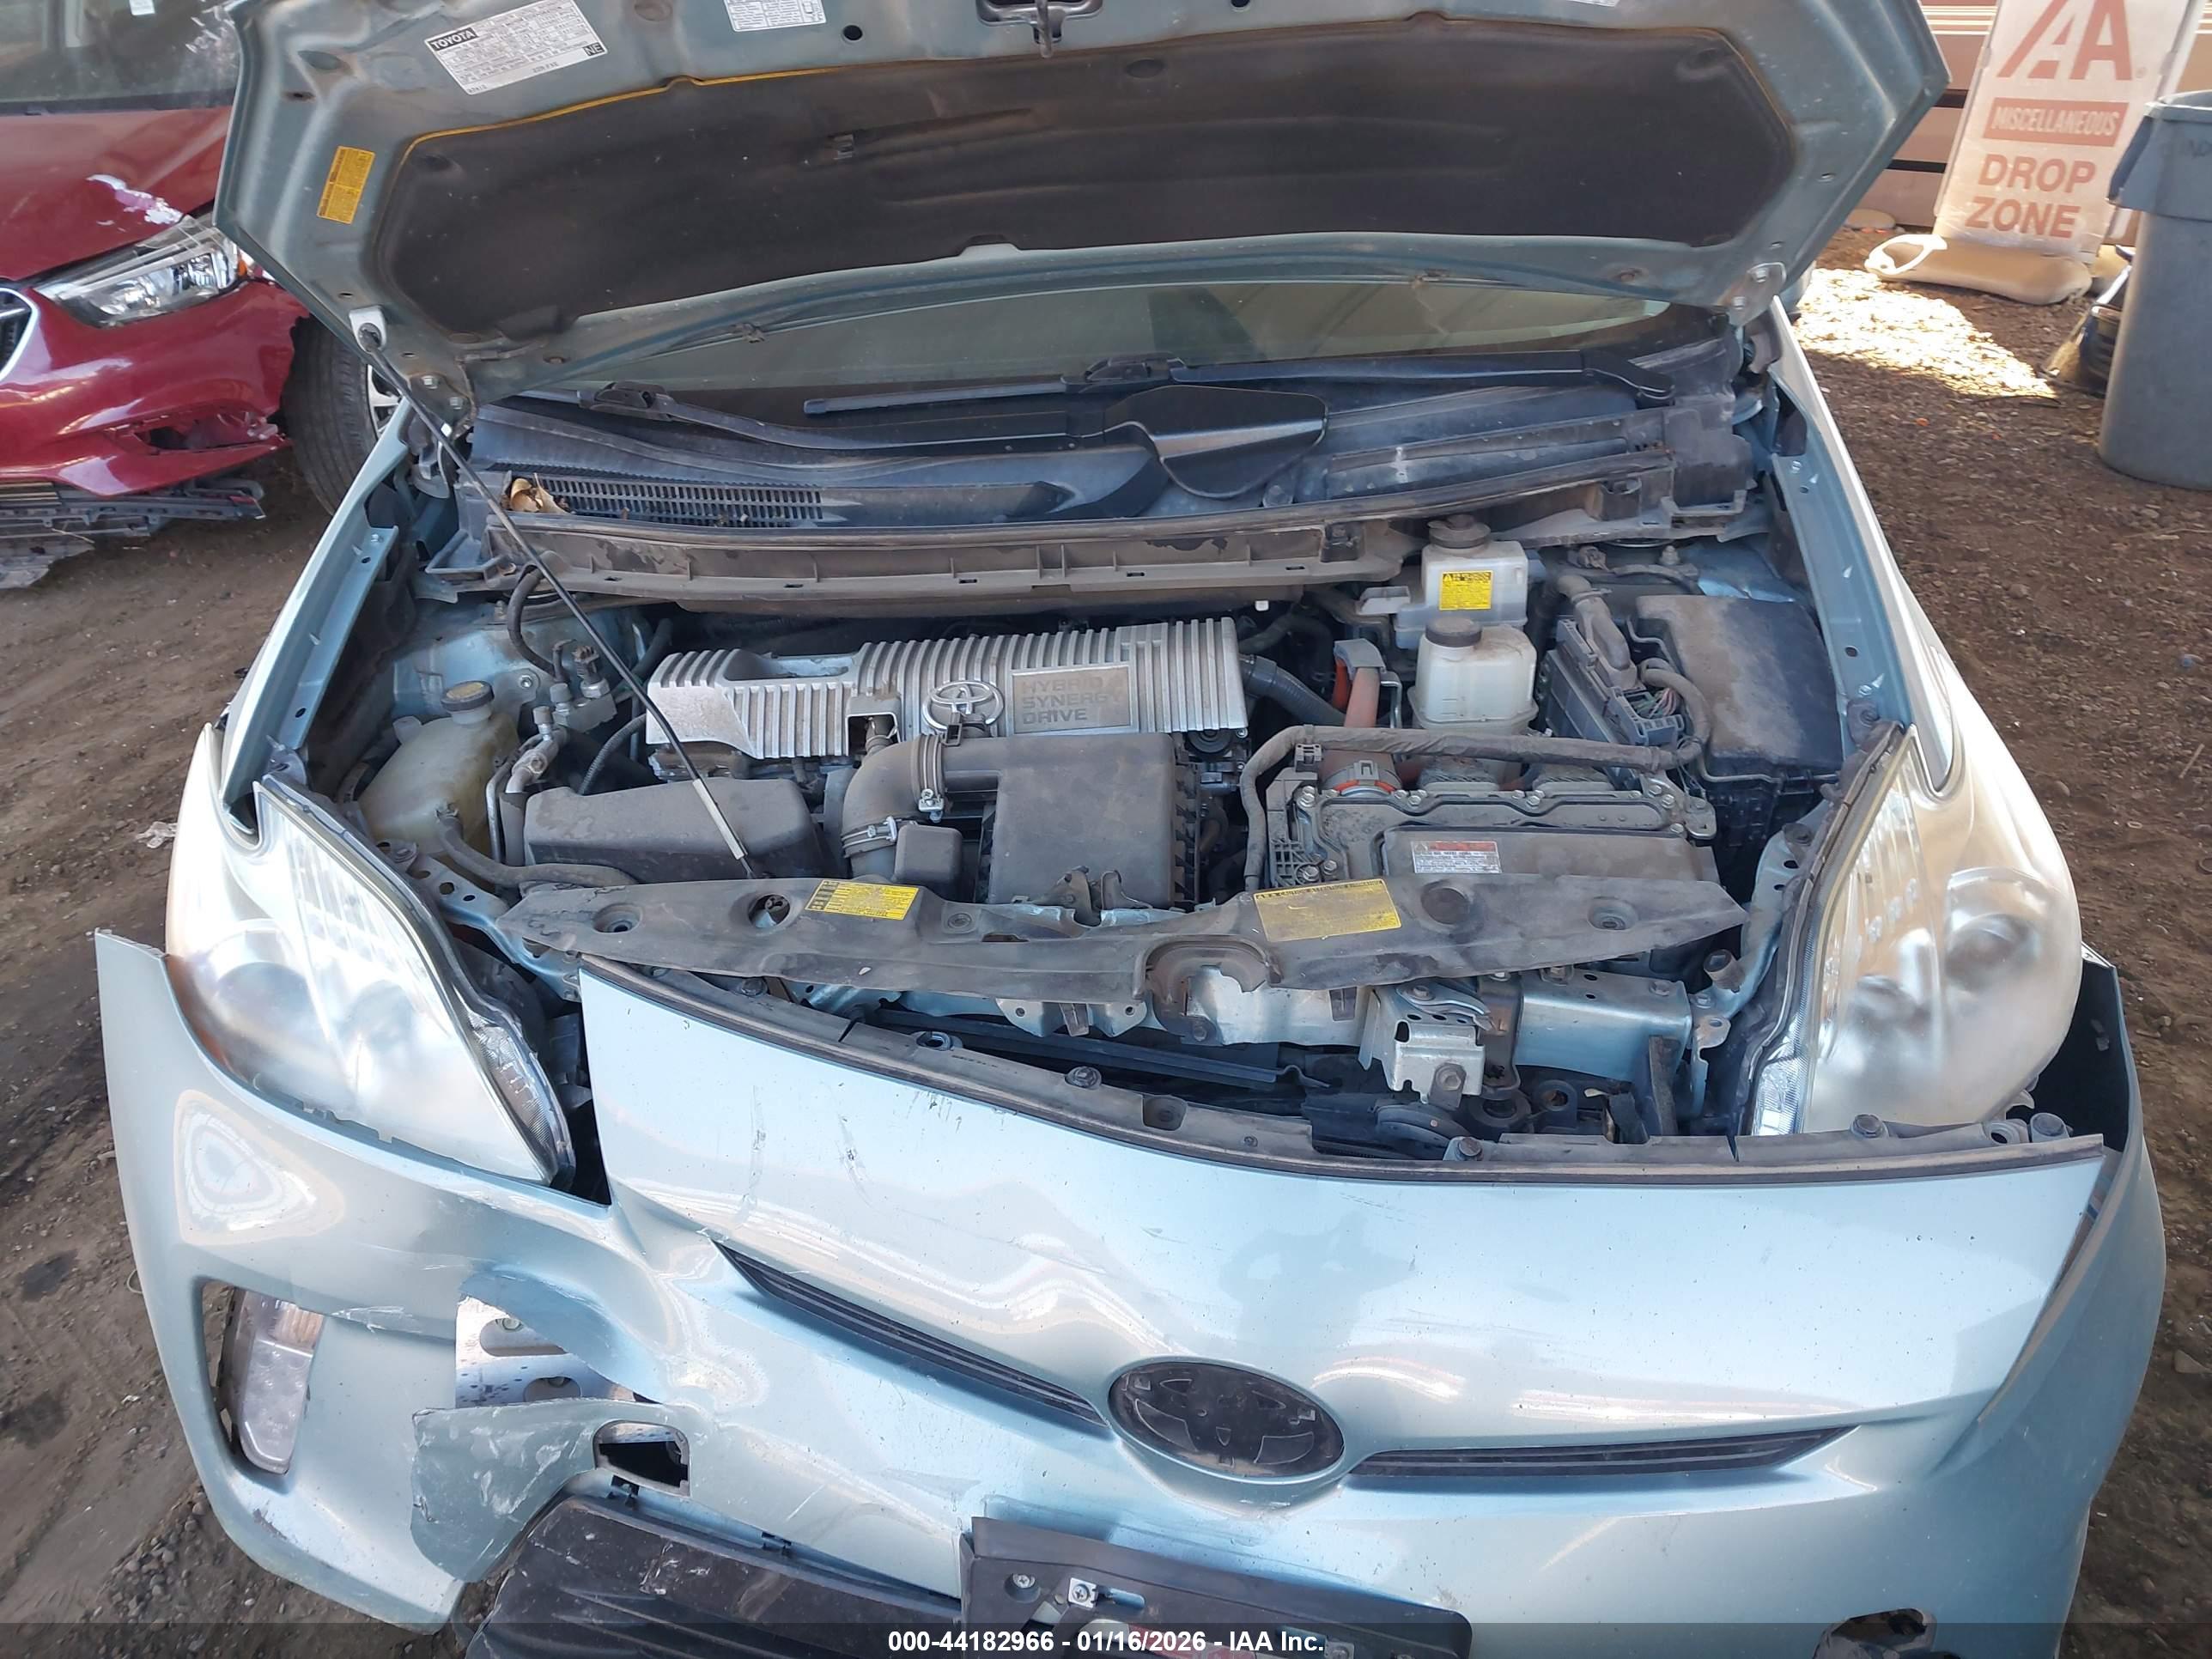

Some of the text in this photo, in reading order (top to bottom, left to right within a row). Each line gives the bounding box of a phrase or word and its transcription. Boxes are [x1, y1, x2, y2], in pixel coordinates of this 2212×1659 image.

[430, 30, 476, 49] TOYOTA
[585, 44, 603, 56] NE
[1992, 106, 2119, 137] MISCELLANEOUS
[1978, 153, 2096, 193] DROP
[1965, 196, 2081, 239] ZONE
[1023, 677, 1103, 694] HYBRID
[1023, 708, 1087, 725] DRIVE
